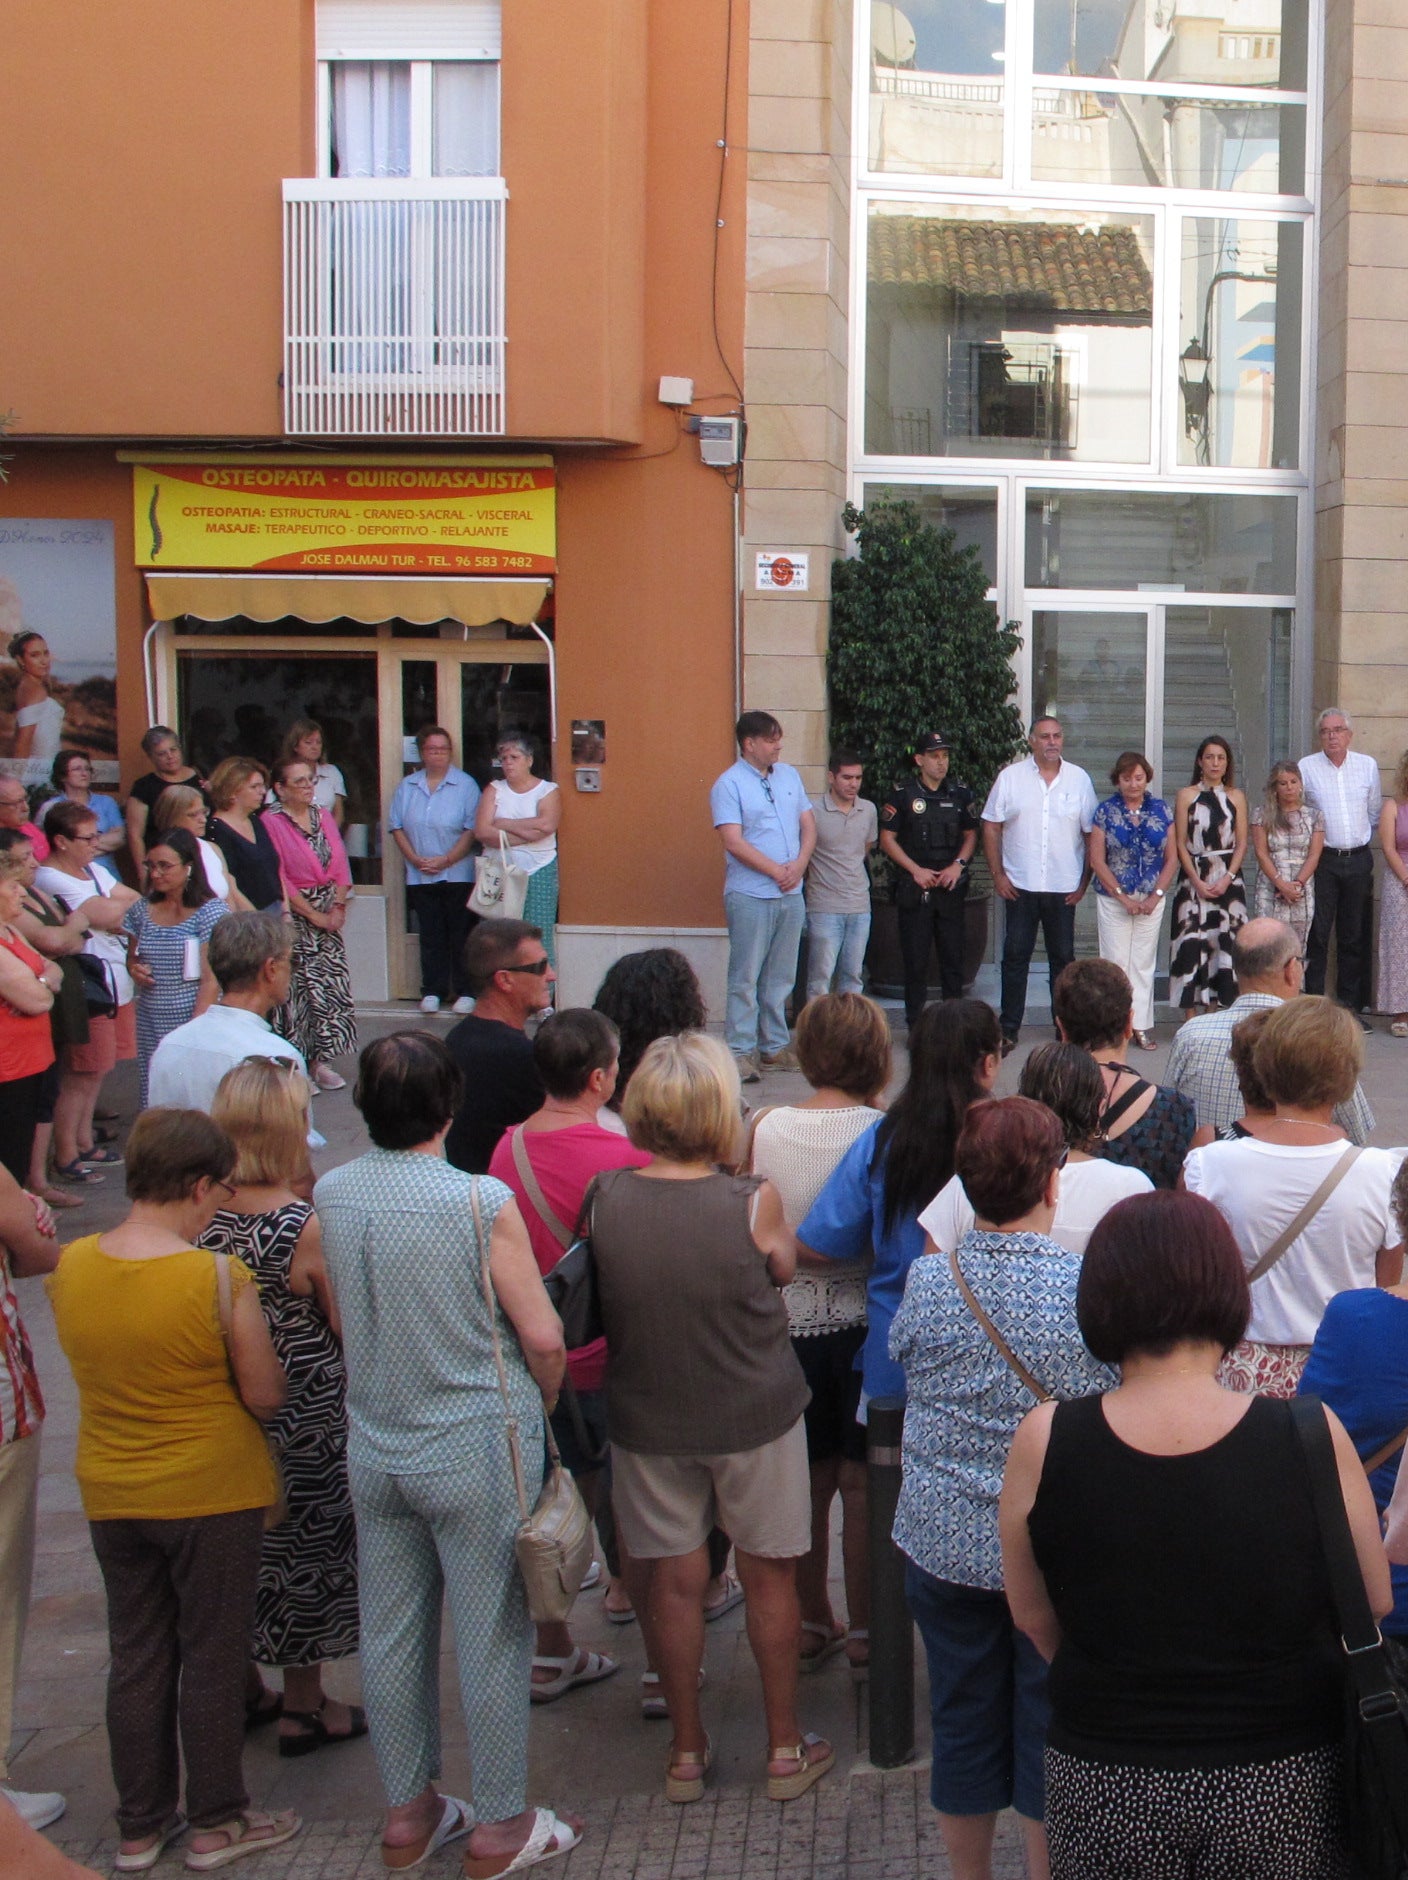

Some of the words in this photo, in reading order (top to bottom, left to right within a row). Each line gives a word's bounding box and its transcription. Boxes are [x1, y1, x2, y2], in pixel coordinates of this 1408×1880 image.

[202, 469, 326, 486] OSTEOPATA
[346, 471, 536, 488] QUIROMASAJISTA
[182, 507, 265, 518] OSTEOPATIA:
[270, 508, 352, 519] ESTRUCTURAL
[363, 509, 465, 520] CRANEO-SACRAL
[477, 510, 534, 520] VISCERAL
[206, 523, 260, 534] MASAJE:
[265, 524, 346, 535] TERAPEUTICO
[358, 525, 428, 536] DEPORTIVO
[440, 526, 509, 537] RELAJANTE
[300, 554, 331, 565] JOSE
[335, 555, 388, 565] DALMAU
[391, 555, 416, 566] TUR
[427, 556, 451, 566] TEL.
[455, 556, 471, 567] 96
[474, 556, 498, 567] 583
[502, 557, 533, 568] 7482
